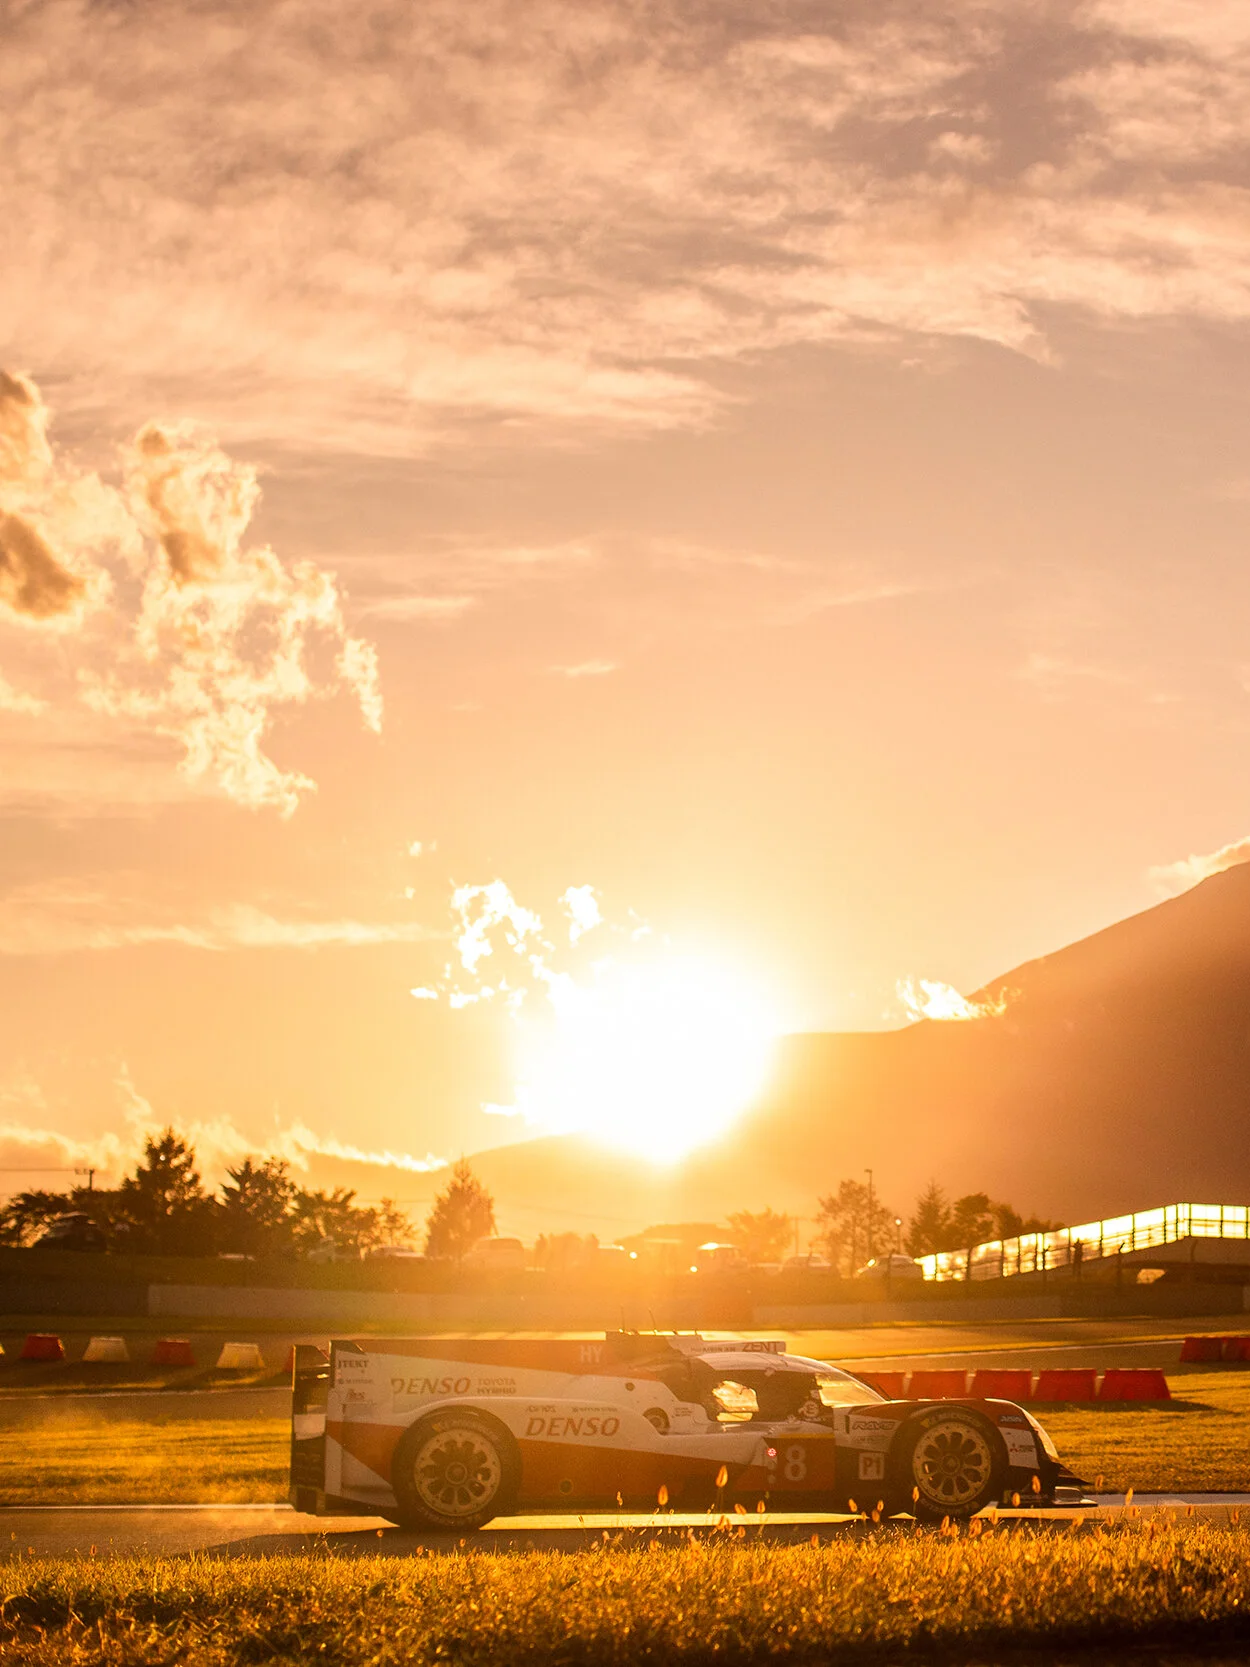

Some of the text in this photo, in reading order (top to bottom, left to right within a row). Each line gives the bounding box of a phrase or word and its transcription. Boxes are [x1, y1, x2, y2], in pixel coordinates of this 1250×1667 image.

[741, 1341, 778, 1353] ZENT
[390, 1377, 471, 1395] DENSO
[478, 1378, 516, 1386] TOYOTA
[525, 1417, 620, 1437] DENSO
[785, 1445, 807, 1481] 8
